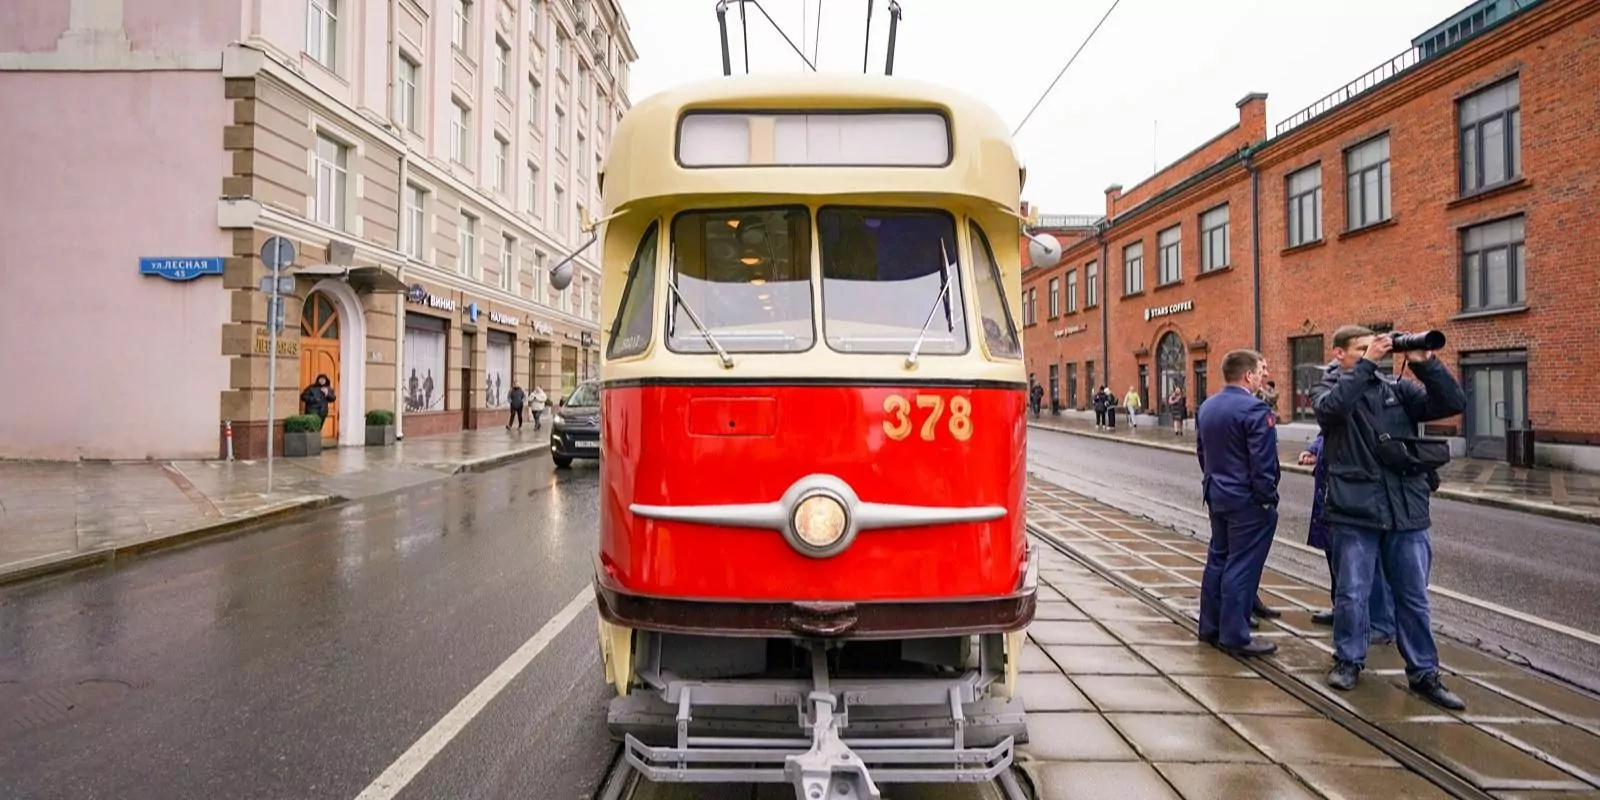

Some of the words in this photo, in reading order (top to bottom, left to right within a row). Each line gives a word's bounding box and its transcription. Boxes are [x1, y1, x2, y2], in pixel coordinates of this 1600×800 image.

[430, 294, 456, 311] ВИНИЛ
[1151, 306, 1169, 318] STARS
[1169, 300, 1192, 313] COFFEE
[883, 394, 973, 441] 378
